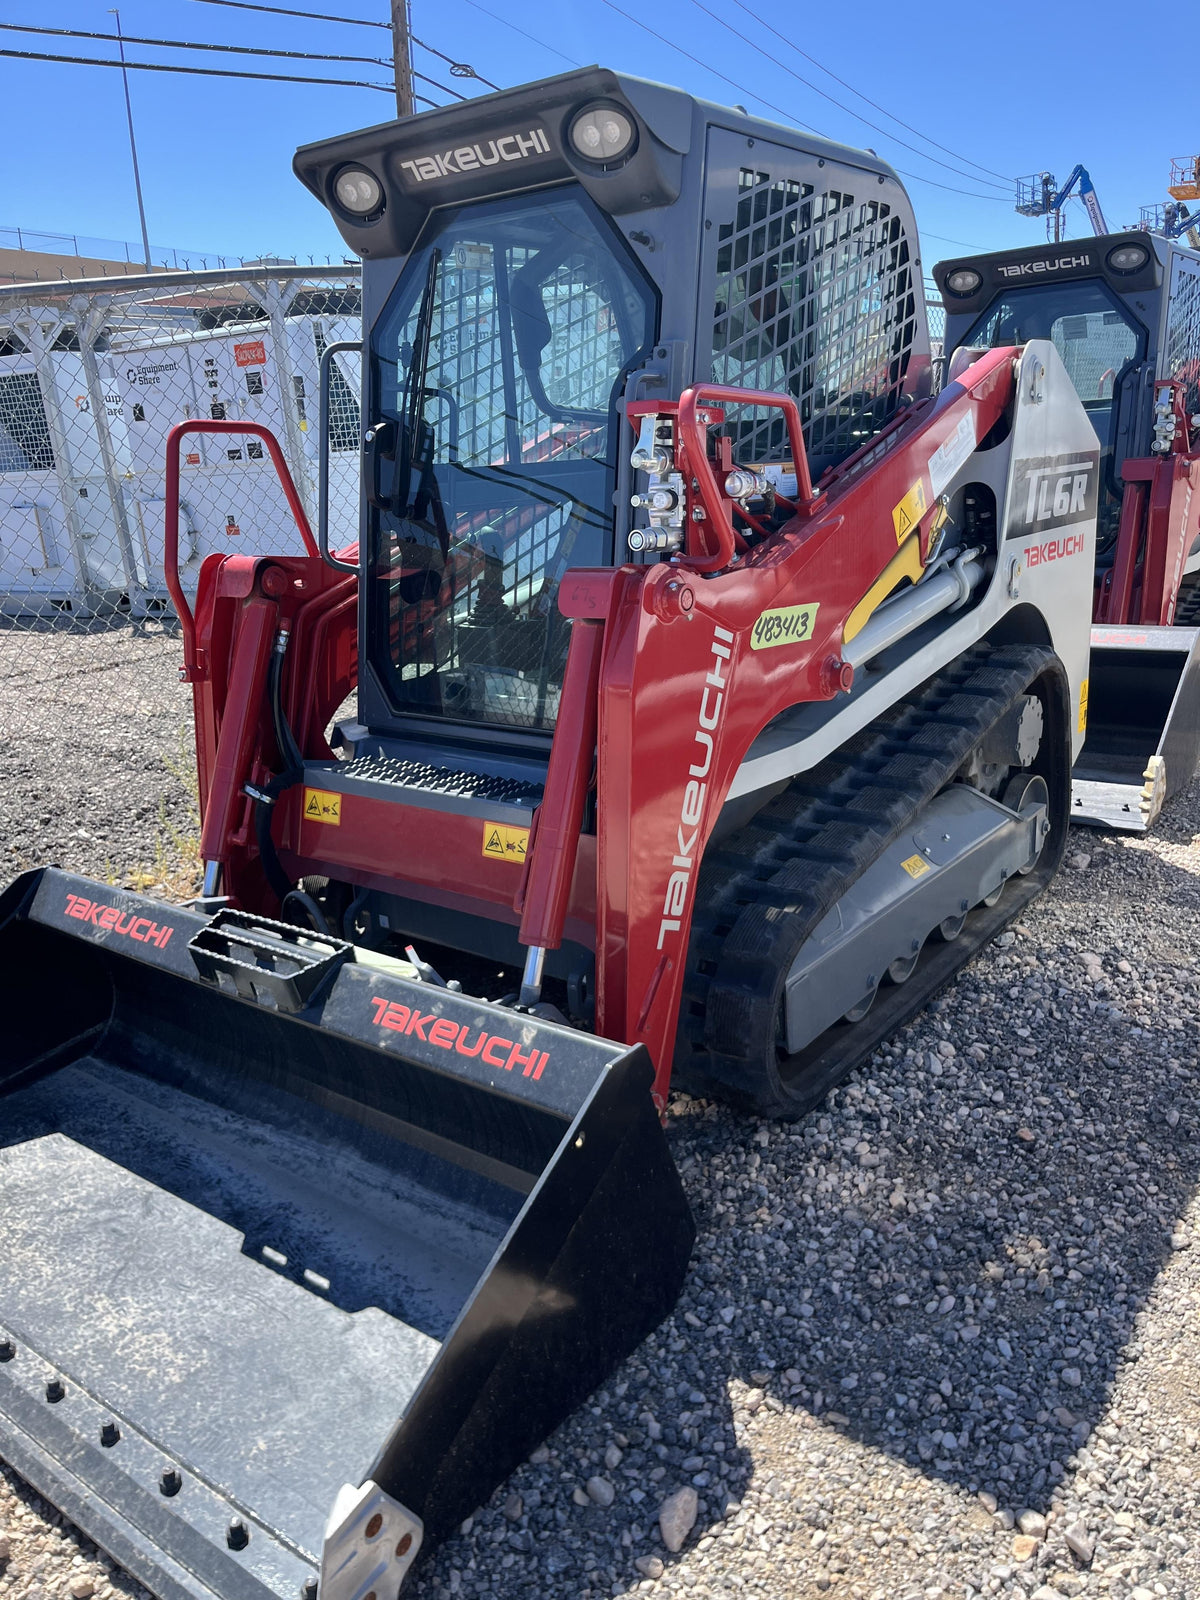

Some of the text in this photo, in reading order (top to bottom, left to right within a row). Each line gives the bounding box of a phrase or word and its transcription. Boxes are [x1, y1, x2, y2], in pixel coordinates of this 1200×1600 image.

[401, 129, 550, 181] TAKEUCHI
[998, 255, 1090, 277] TAKEUCHI
[137, 362, 179, 376] Equipment
[138, 376, 161, 385] Share
[1025, 461, 1094, 524] TL6R
[1023, 533, 1085, 568] TAKEUCHI
[754, 612, 810, 644] 483413
[657, 625, 735, 950] TAKEUCHI
[65, 893, 174, 949] TAKEUCHI
[371, 996, 551, 1081] TAKEUCHI
